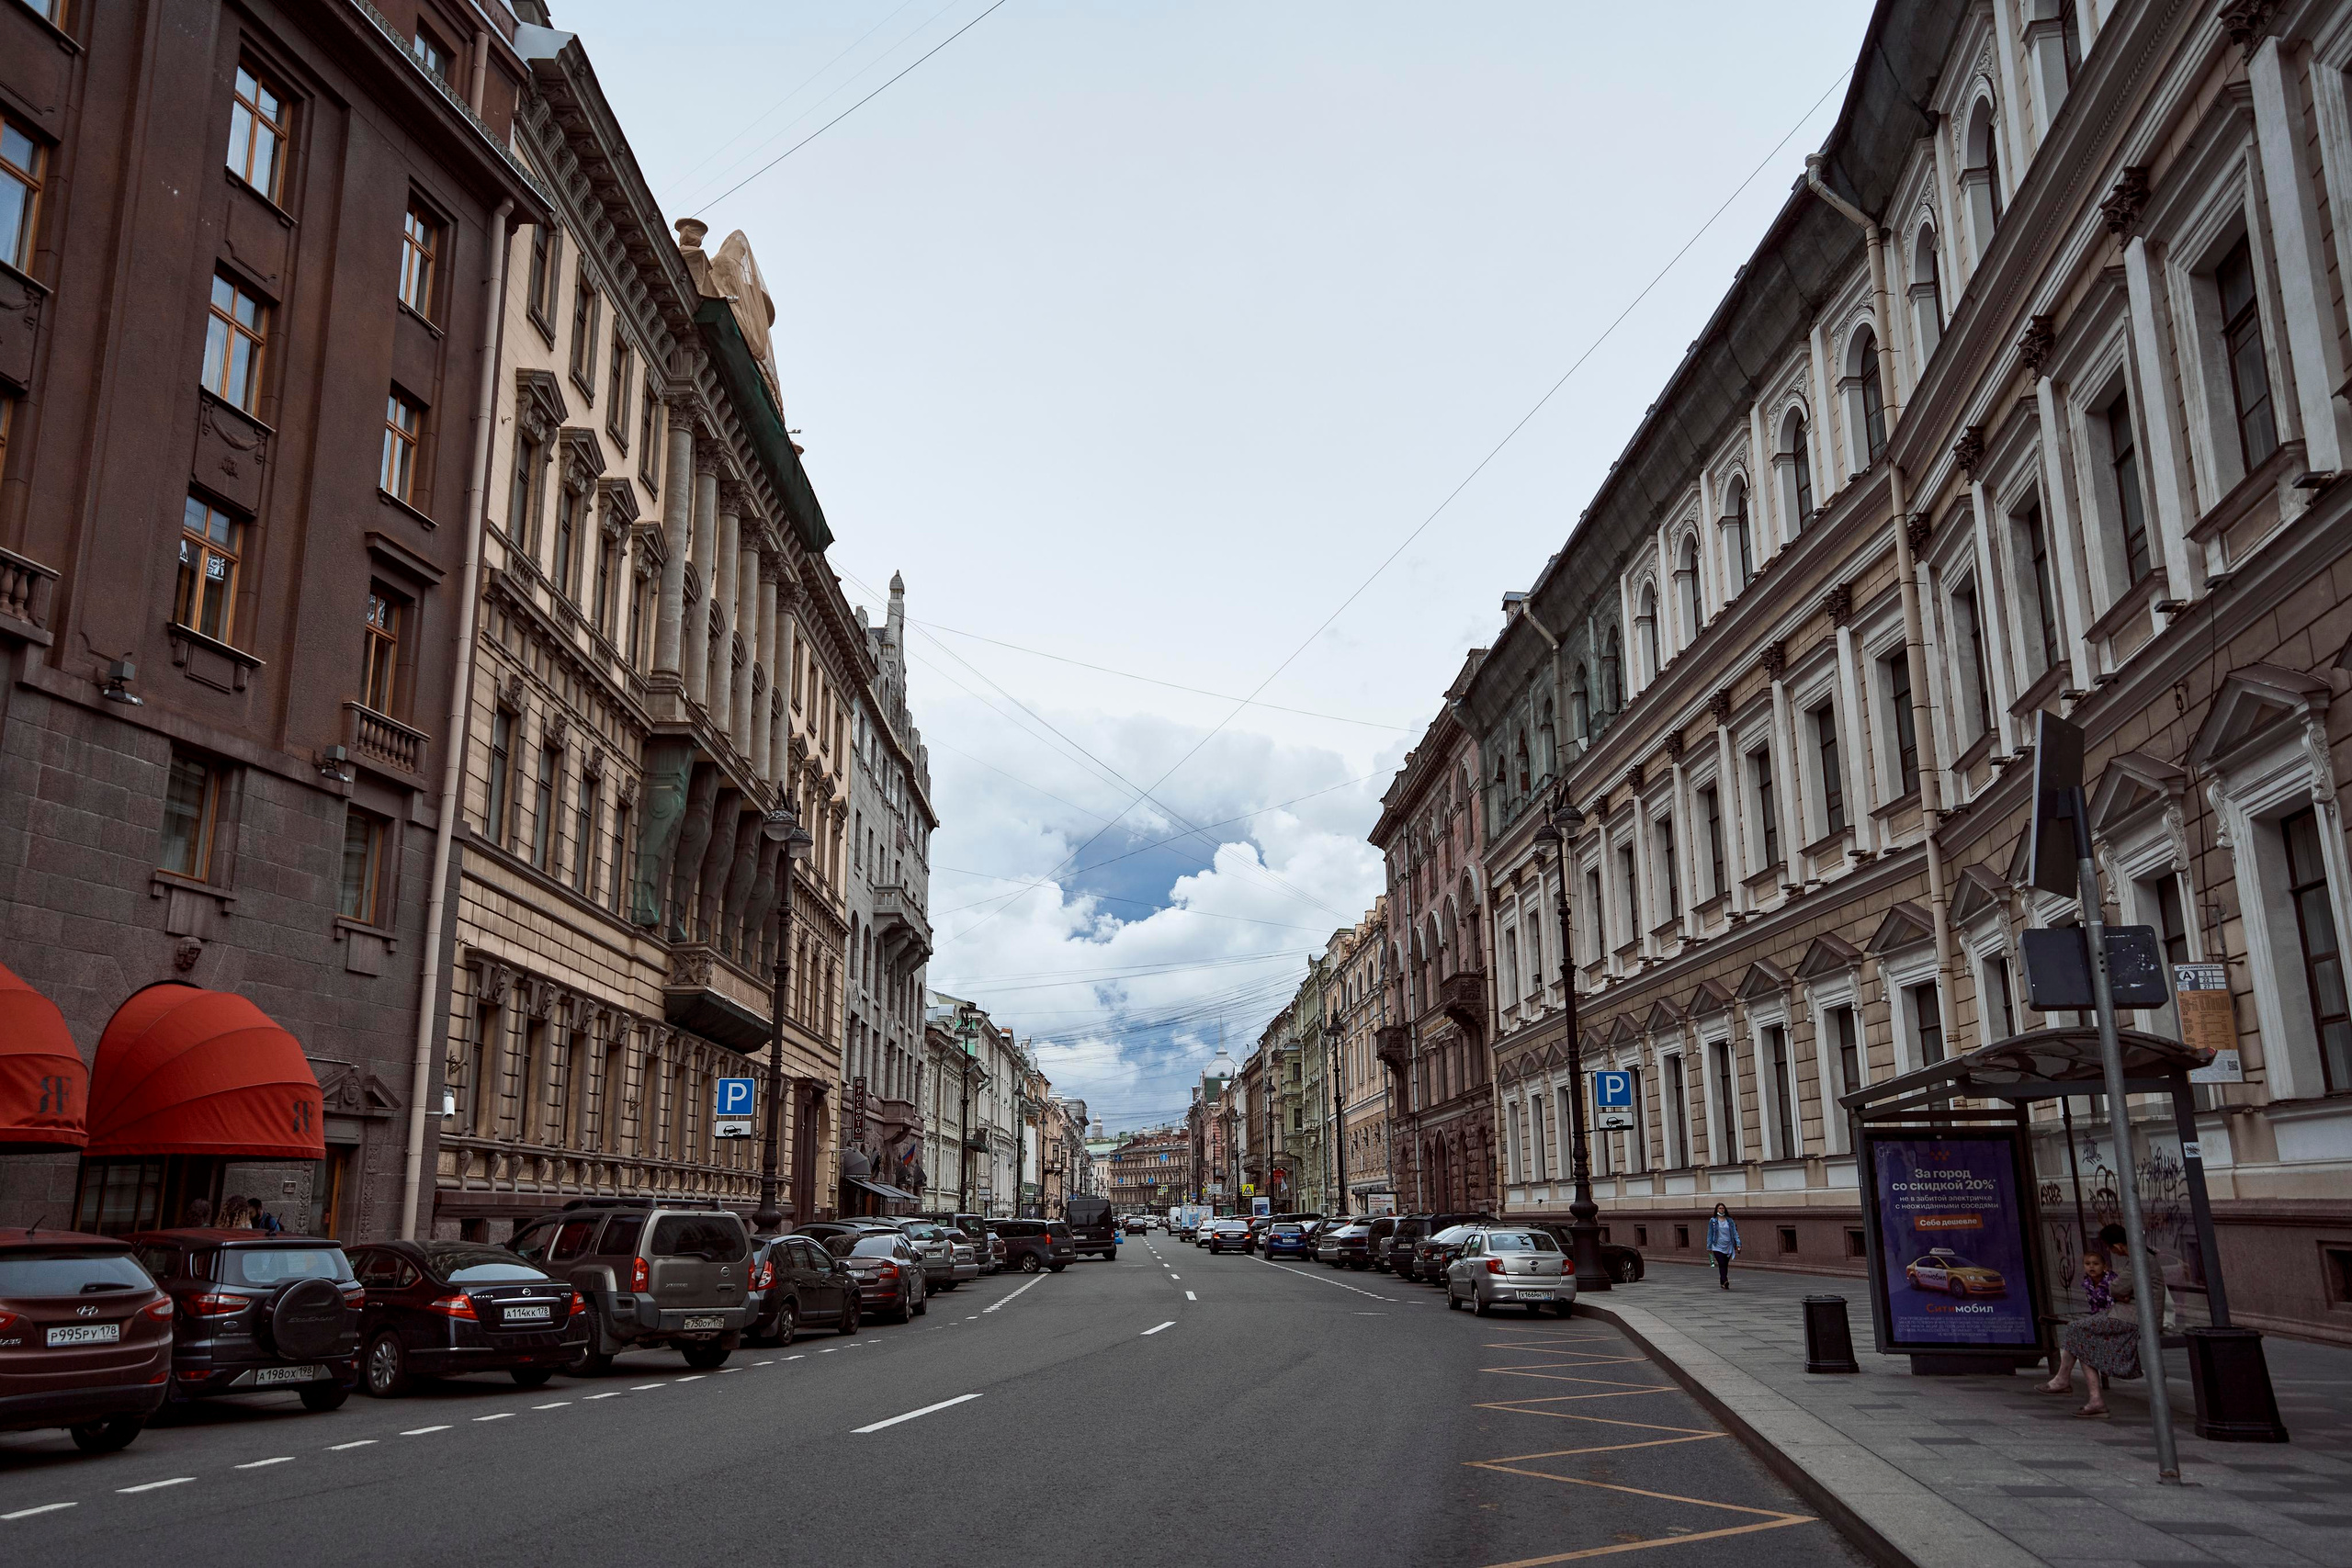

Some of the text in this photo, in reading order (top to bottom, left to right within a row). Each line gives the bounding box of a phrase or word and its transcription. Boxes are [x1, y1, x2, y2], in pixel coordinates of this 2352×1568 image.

[1605, 1075, 1624, 1103] P
[727, 1082, 747, 1111] P
[1878, 1147, 1890, 1157] 0+
[1915, 1168, 1971, 1180] За город
[1893, 1182, 1907, 1190] со
[1910, 1179, 1963, 1191] скидкой
[1941, 1218, 1977, 1227] дешевле
[506, 1306, 548, 1318] А114КК 178
[1926, 1303, 1994, 1314] Ситимобил
[51, 1325, 117, 1342] Р995РУ 178
[259, 1365, 312, 1381] А198ОХ 198
